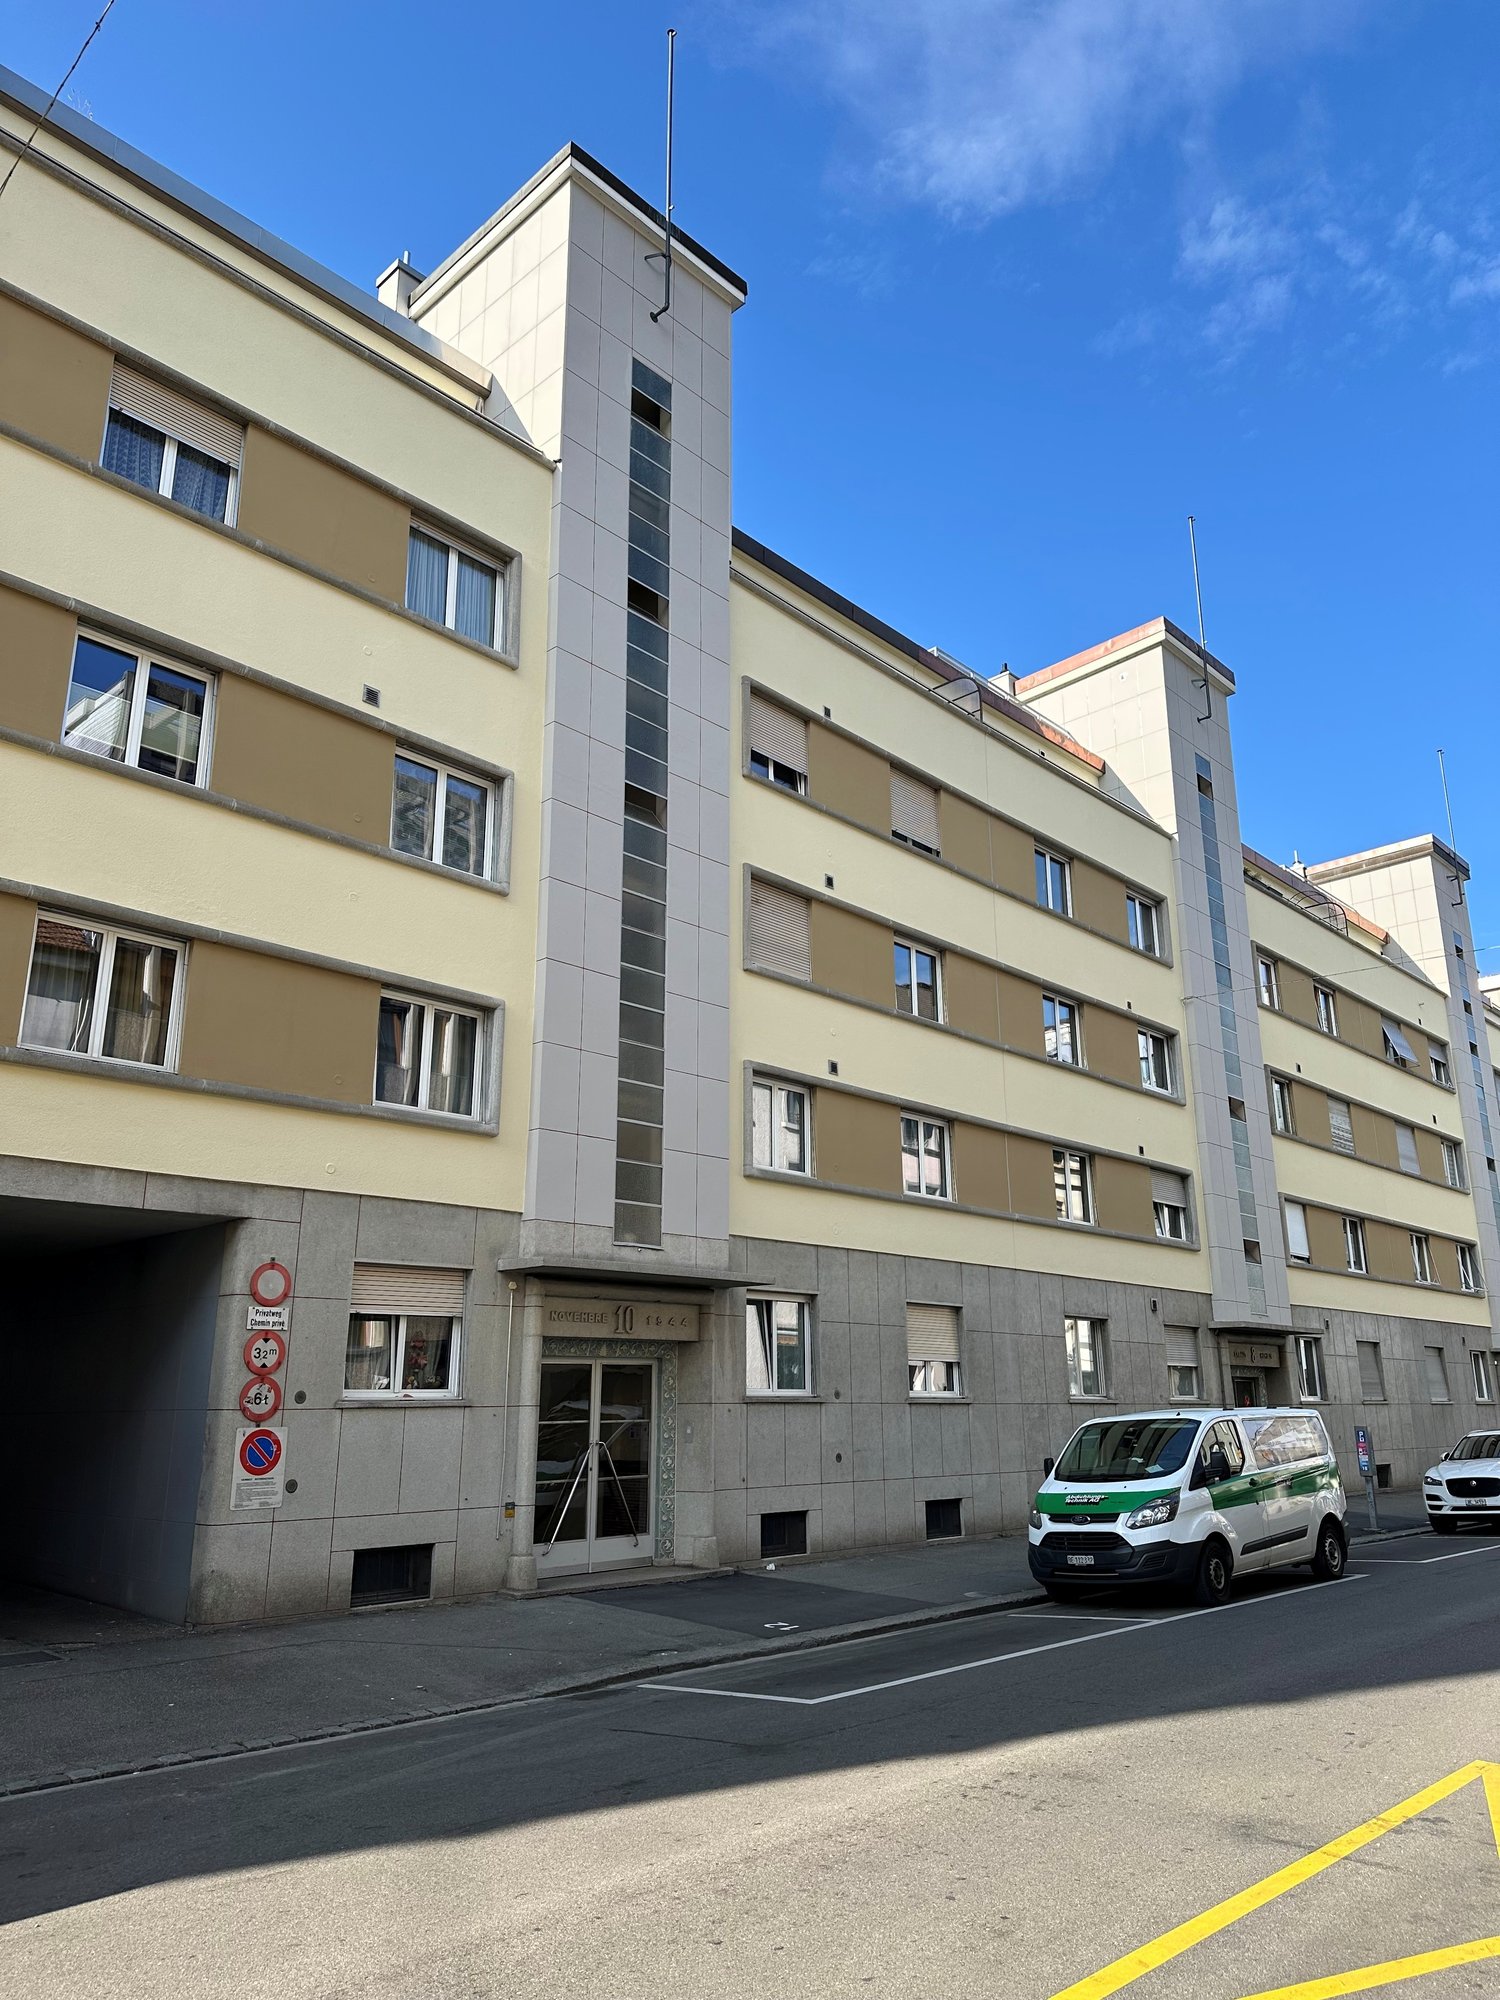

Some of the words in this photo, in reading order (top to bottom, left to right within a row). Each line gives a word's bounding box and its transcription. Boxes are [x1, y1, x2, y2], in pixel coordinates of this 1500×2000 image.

[255, 1309, 282, 1318] Privatweg
[250, 1318, 270, 1327] Chemin
[550, 1310, 608, 1324] NOVEMBRE
[614, 1304, 635, 1335] 10
